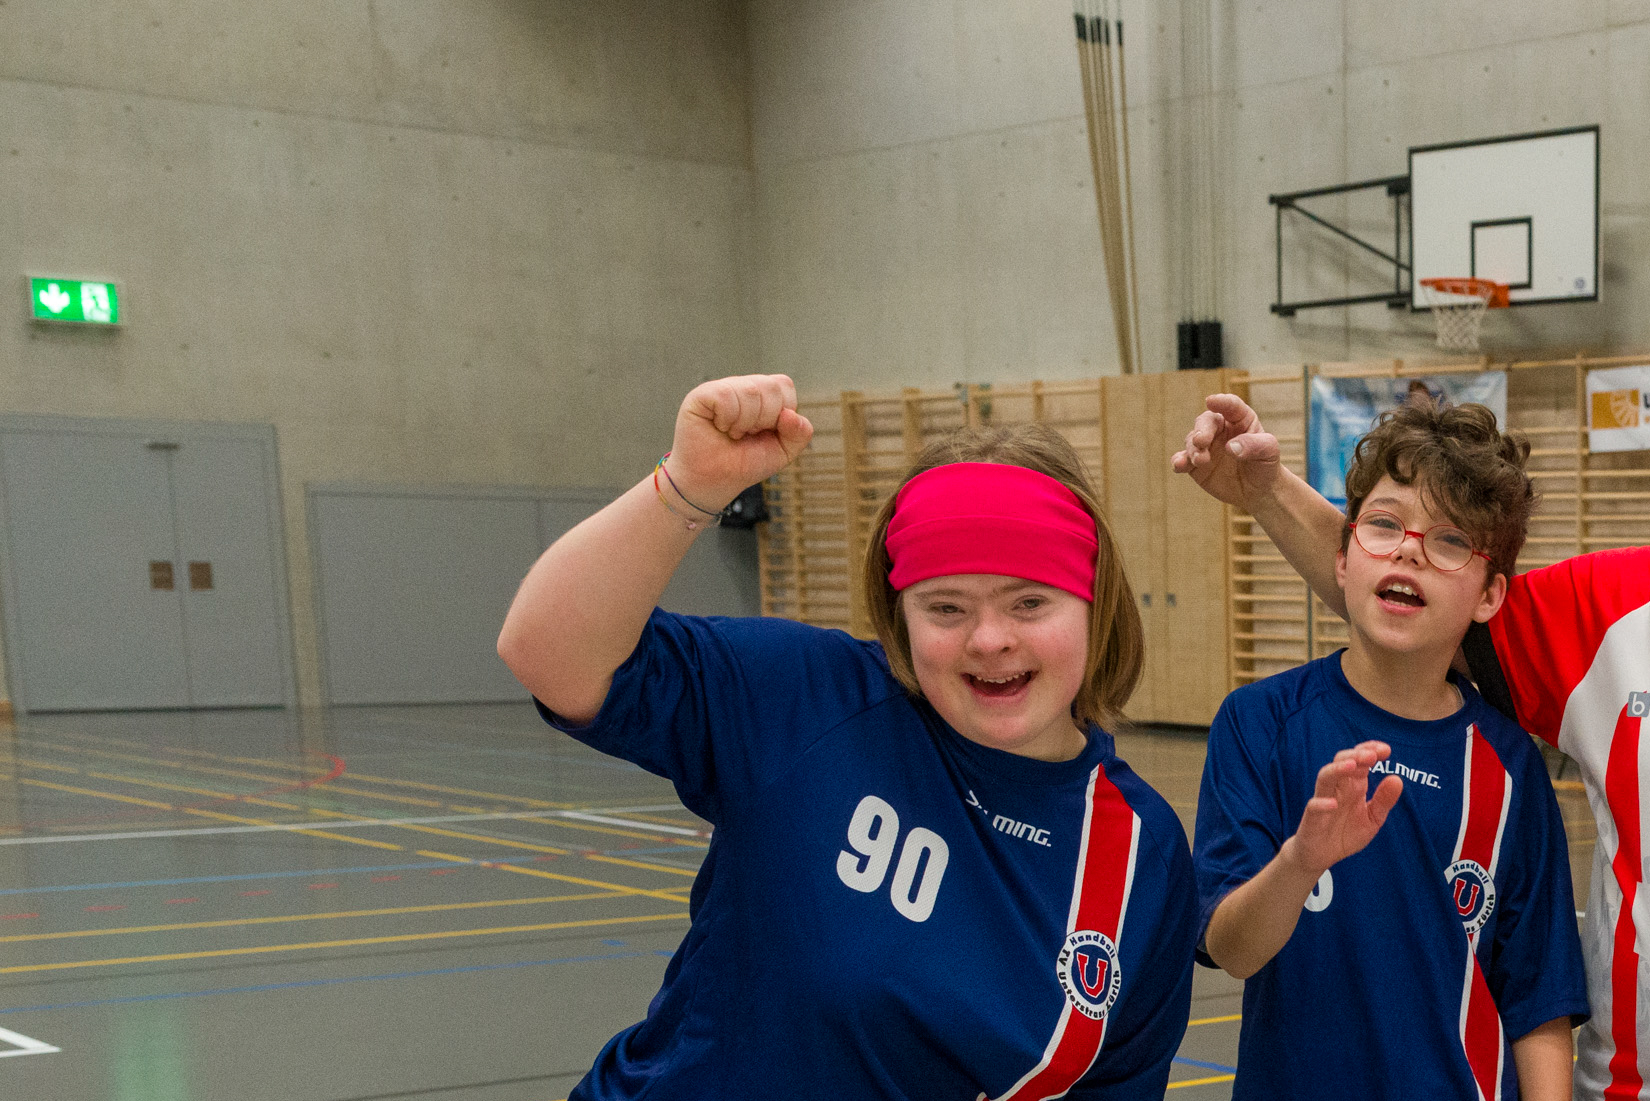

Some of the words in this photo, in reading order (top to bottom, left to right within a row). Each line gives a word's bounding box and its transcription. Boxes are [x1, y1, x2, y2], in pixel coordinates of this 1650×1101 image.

[836, 795, 950, 923] 90
[1059, 949, 1070, 966] TV
[1069, 934, 1115, 958] Handball
[1076, 952, 1108, 998] U
